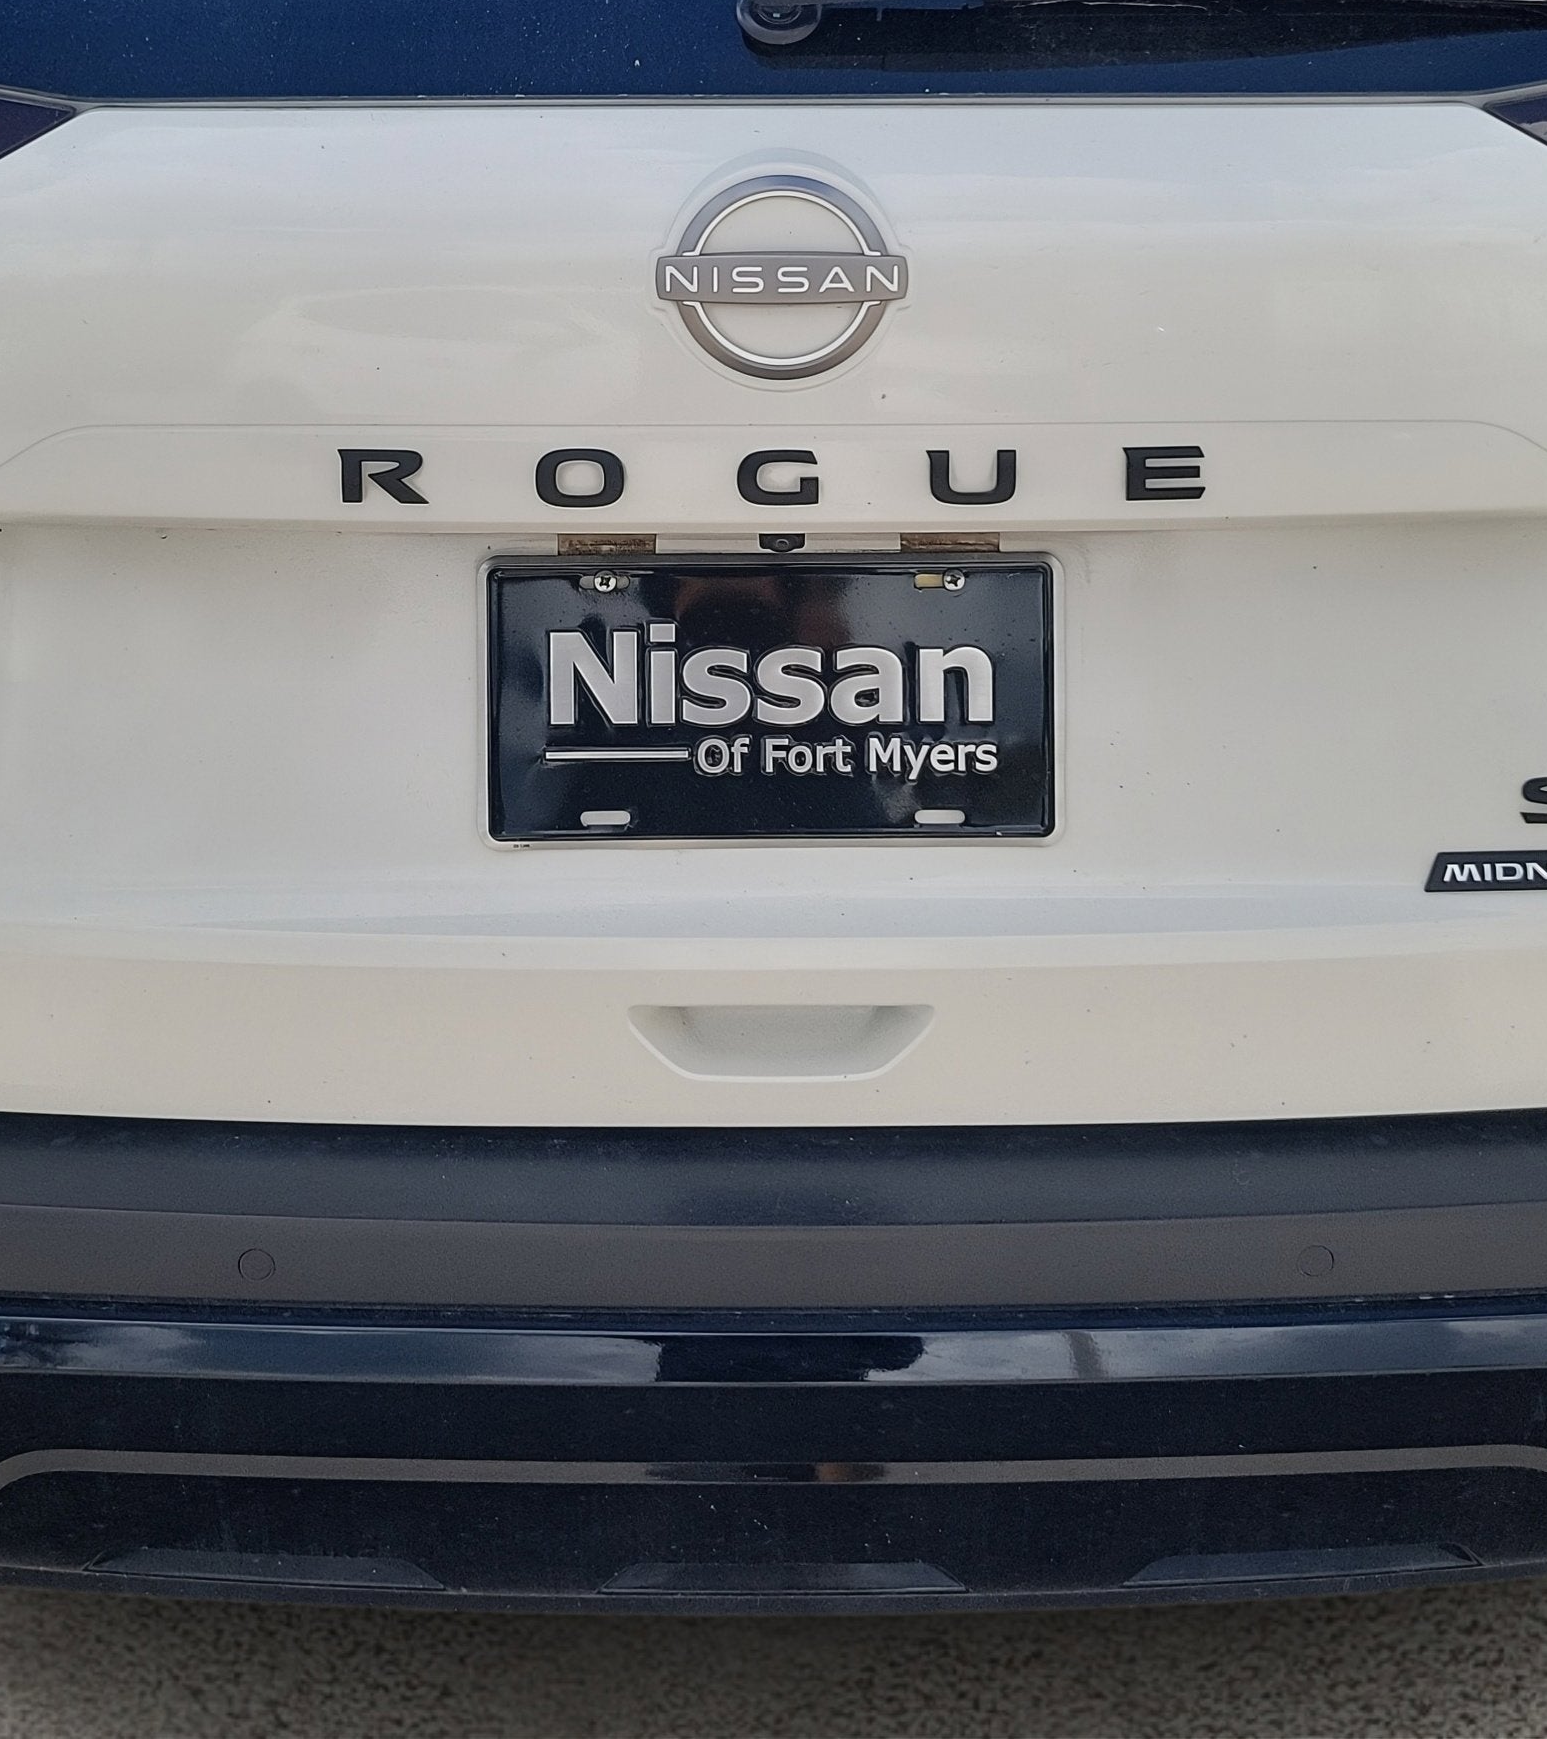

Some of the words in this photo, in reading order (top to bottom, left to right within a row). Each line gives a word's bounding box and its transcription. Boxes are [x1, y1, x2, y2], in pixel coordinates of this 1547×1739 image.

[665, 265, 899, 293] NISSAN
[337, 445, 1207, 506] ROGUE
[549, 622, 994, 726] Nissan
[697, 737, 751, 773] Of
[766, 737, 853, 773] Fort
[869, 737, 998, 780] Myers
